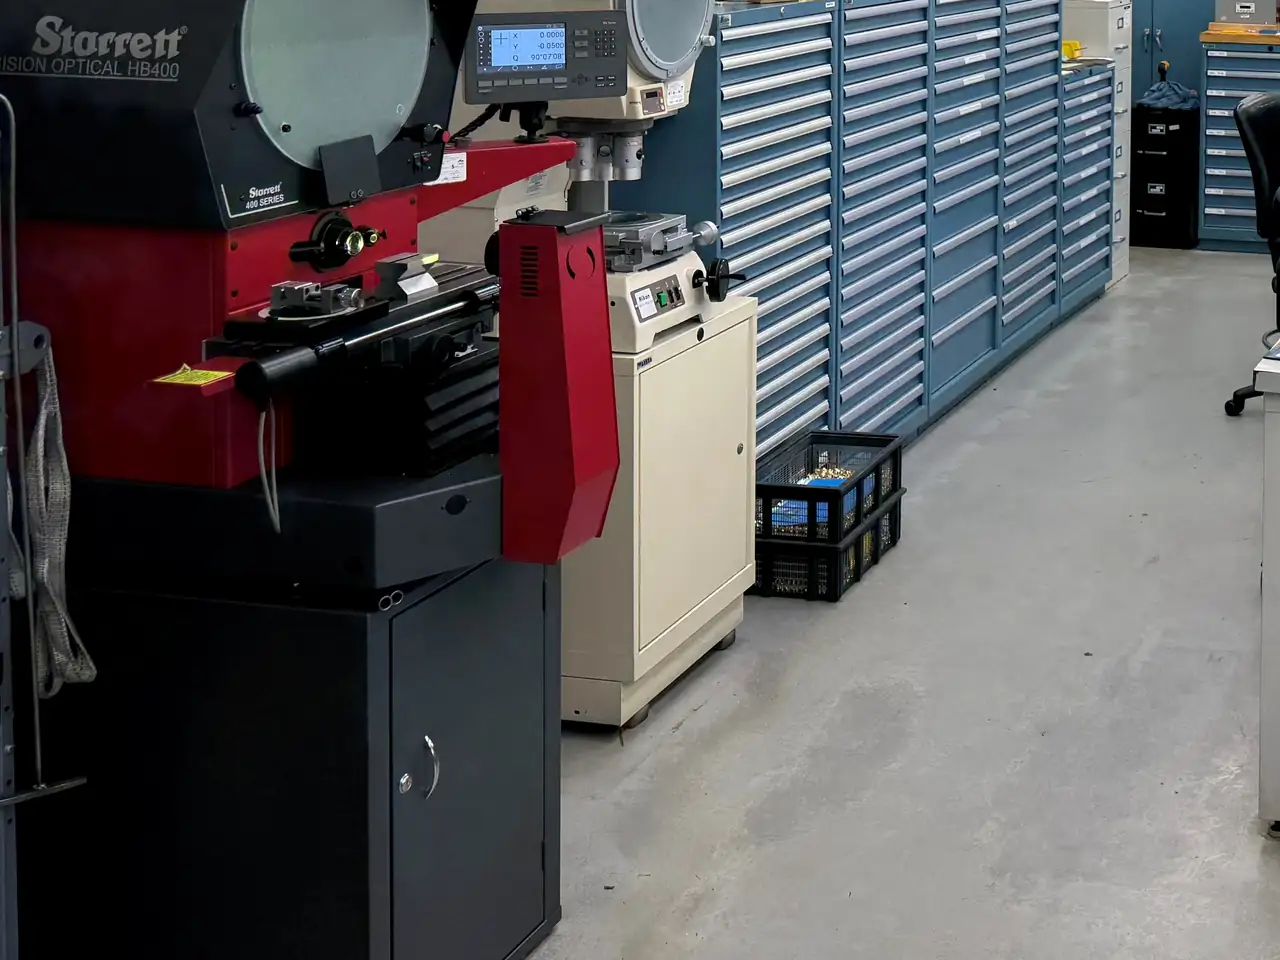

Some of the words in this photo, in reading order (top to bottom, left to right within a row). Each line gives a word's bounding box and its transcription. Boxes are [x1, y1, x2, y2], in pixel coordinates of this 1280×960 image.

[0, 55, 46, 72] ISION
[51, 58, 123, 76] OPTICAL
[128, 61, 179, 78] HB400
[246, 199, 258, 209] 400
[259, 194, 284, 208] SERIES
